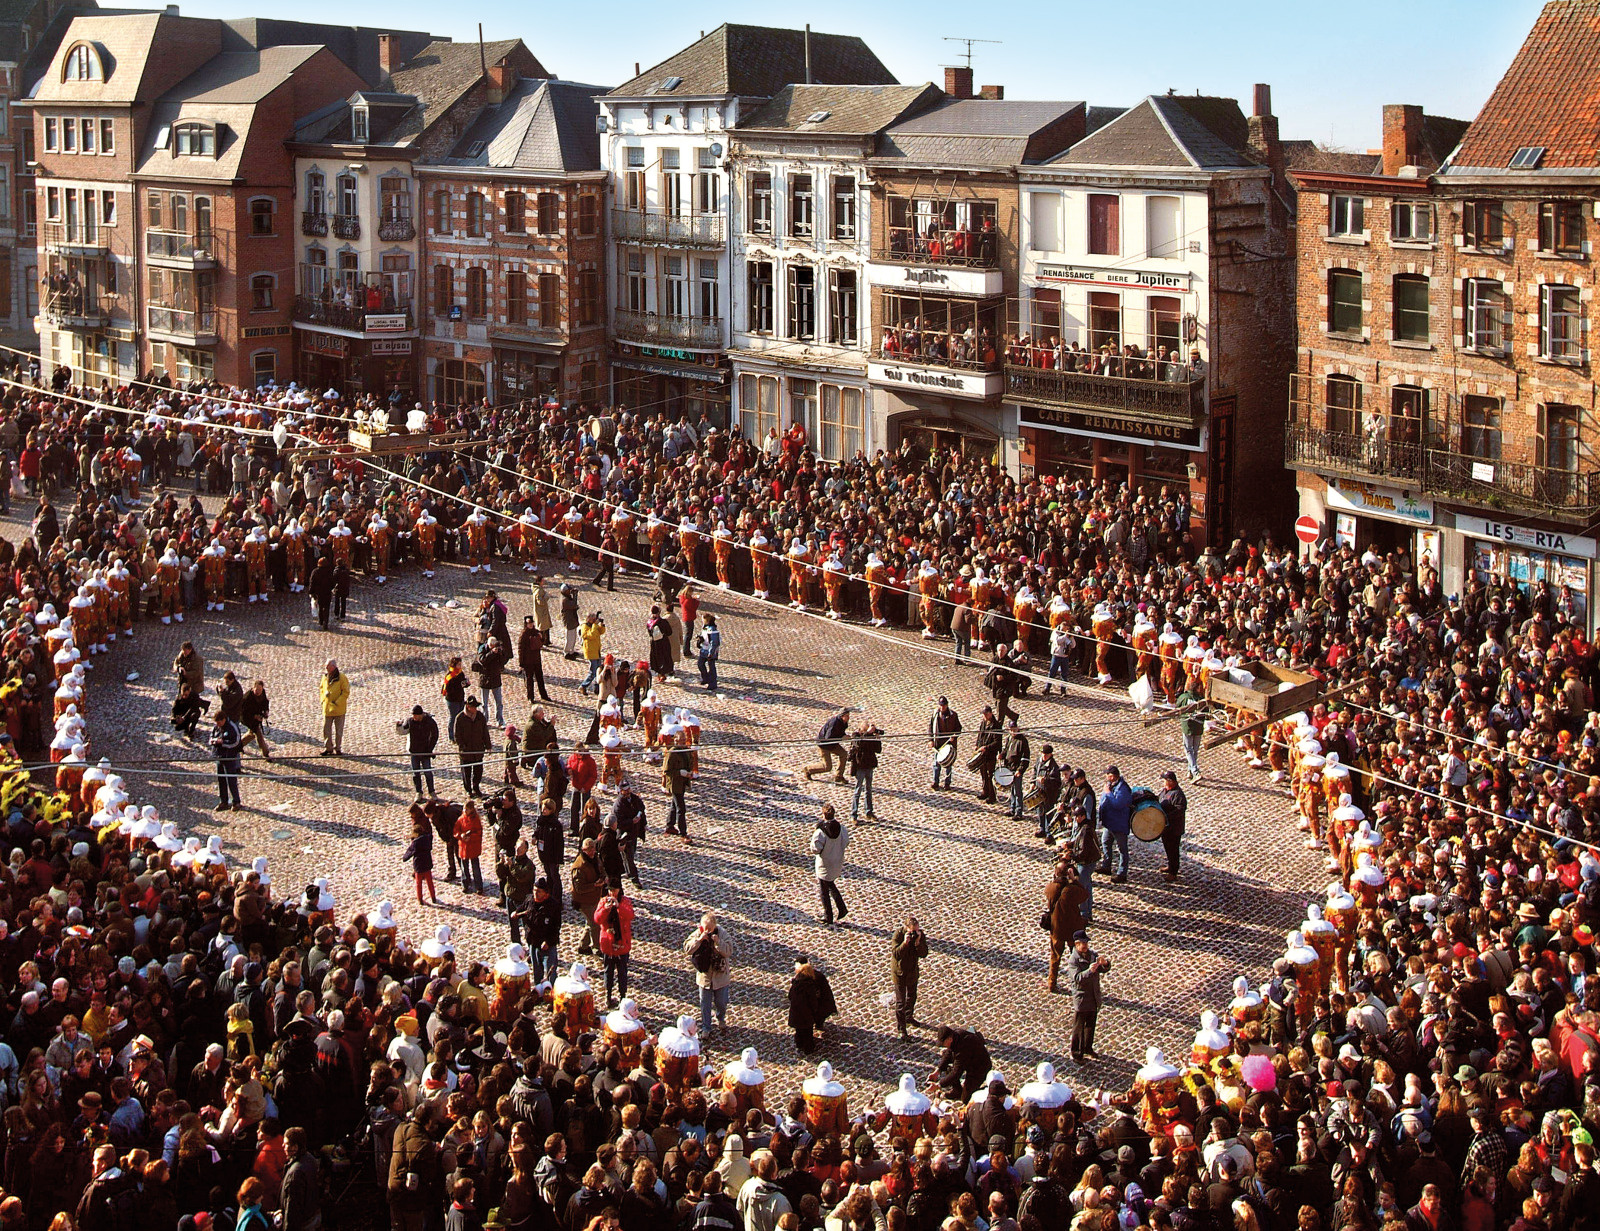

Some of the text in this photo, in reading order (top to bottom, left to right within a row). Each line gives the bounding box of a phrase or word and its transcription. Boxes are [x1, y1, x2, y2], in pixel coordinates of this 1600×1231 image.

[904, 267, 949, 284] Jupiler
[1043, 269, 1180, 288] RENAISSANCE BIERE Jupiler
[906, 372, 964, 390] TOURISME
[1085, 415, 1181, 439] RENAISSANCE
[1361, 489, 1396, 511] TRAVEL
[1485, 522, 1501, 537] LE
